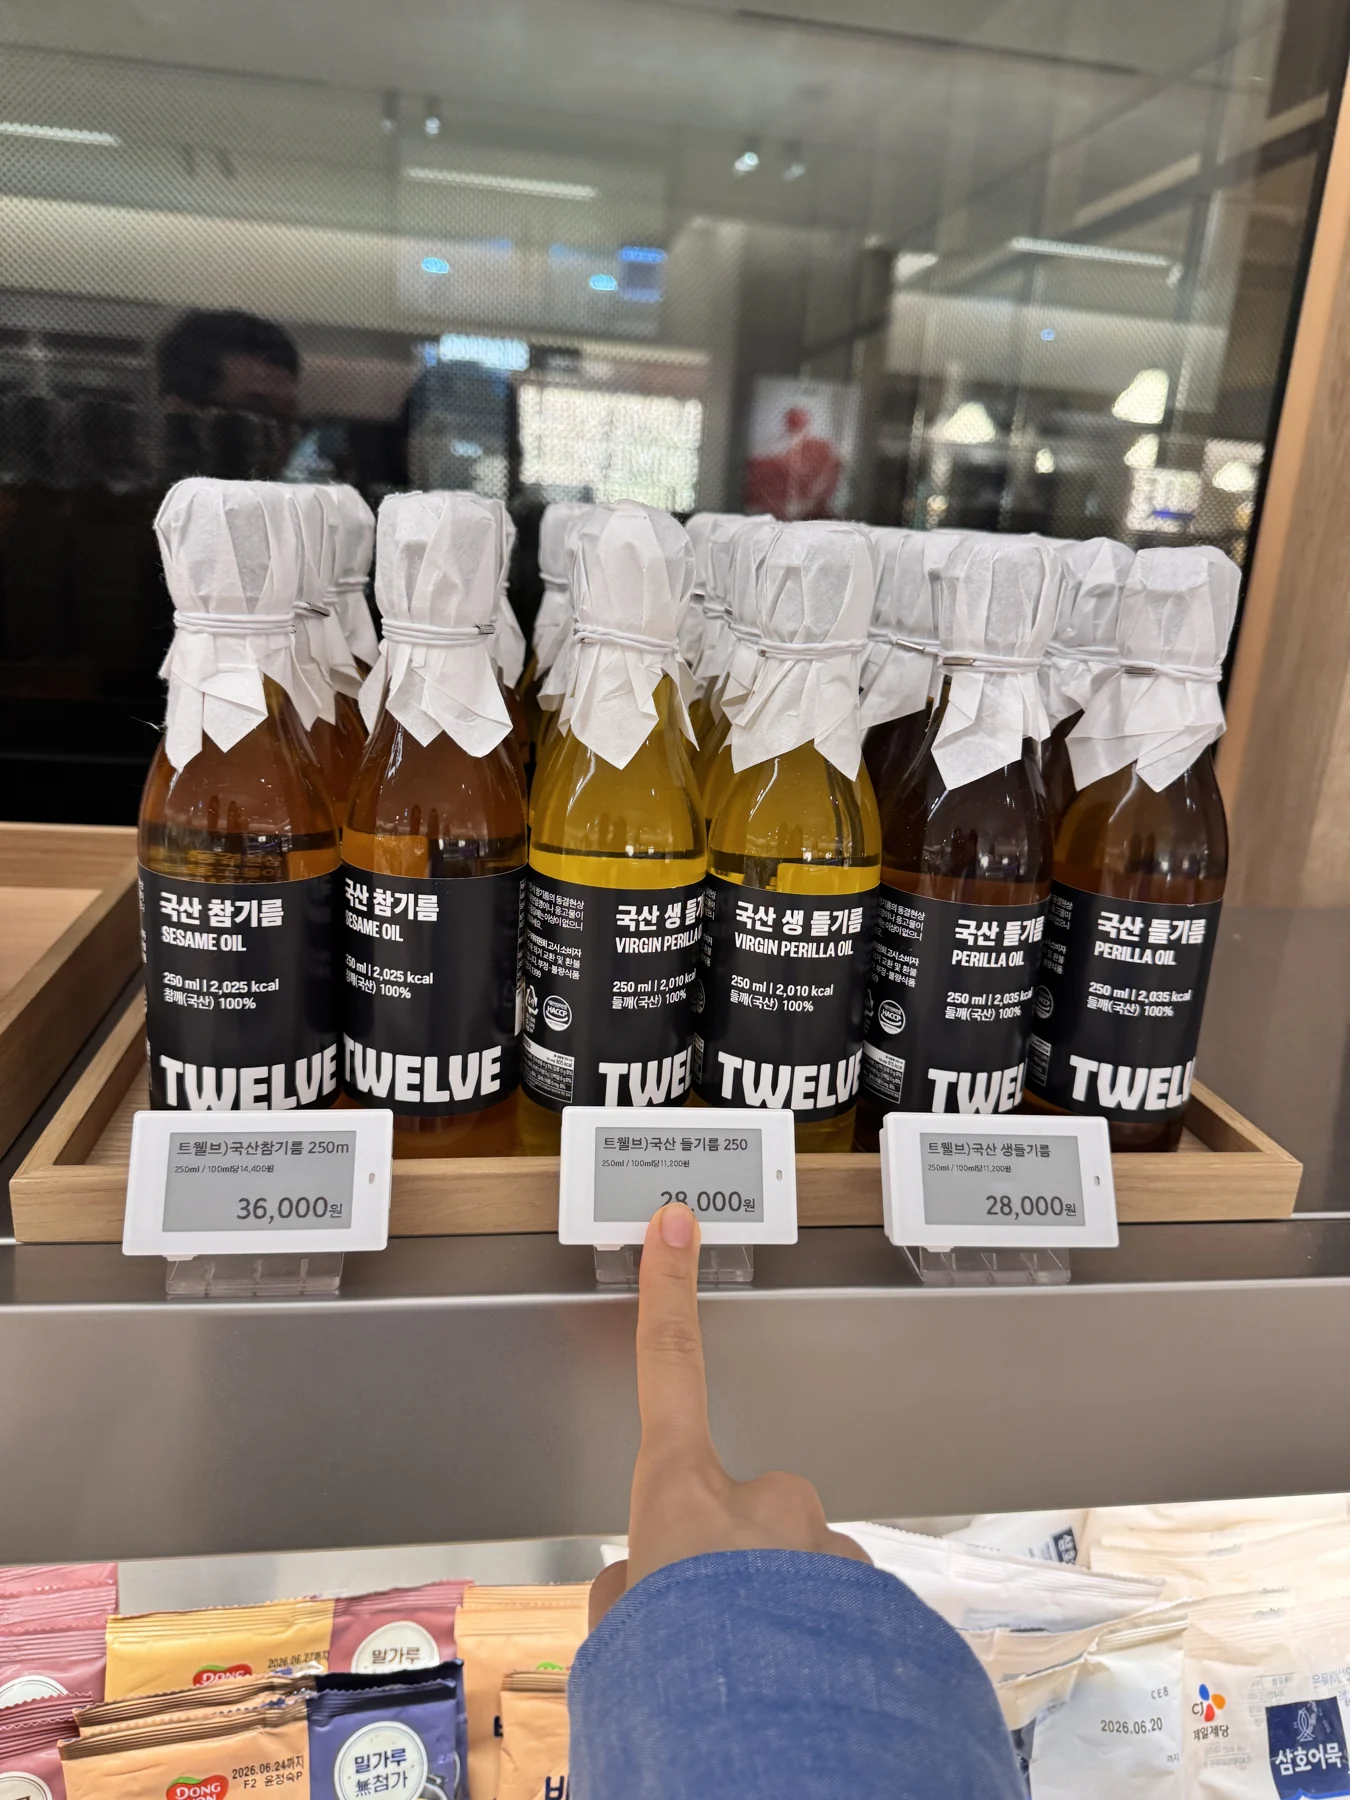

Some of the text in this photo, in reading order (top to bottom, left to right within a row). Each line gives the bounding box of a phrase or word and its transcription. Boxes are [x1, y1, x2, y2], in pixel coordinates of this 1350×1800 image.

[159, 891, 284, 928] 국산 참기름
[344, 877, 440, 922] 국산 참기름
[344, 909, 404, 942] SESAME OIL
[616, 905, 660, 931] 국산
[664, 902, 682, 929] 생
[735, 901, 776, 932] 국산
[782, 909, 804, 936] 생
[810, 907, 863, 937] 들기름
[1097, 911, 1145, 942] 국산
[1148, 918, 1206, 945] 들기름
[161, 926, 247, 951] SESAME OIL
[615, 937, 662, 953] VIRGIN
[663, 926, 698, 951] PERILLA
[955, 919, 1000, 946] 국산
[1003, 915, 1045, 947] 들기름
[560, 946, 582, 958] 소비자
[734, 932, 778, 957] VIRGIN
[781, 939, 836, 958] PERILLA
[837, 940, 854, 957] OIL
[1094, 941, 1177, 966] PERILLA OIL
[898, 954, 919, 966] 소비자
[951, 949, 1025, 967] PERILLA OIL
[162, 971, 183, 988] 250
[184, 978, 200, 991] ml
[210, 981, 249, 995] 2,025
[251, 978, 279, 993] kcal
[356, 961, 367, 975] ml
[373, 966, 405, 983] 2,025
[407, 971, 434, 985] kcal
[613, 981, 635, 993] 250
[637, 980, 651, 992] ml
[660, 975, 684, 991] 2,010
[685, 968, 697, 984] kcal
[380, 983, 412, 999] 100%
[731, 974, 750, 989] 250
[752, 981, 767, 993] ml
[776, 983, 809, 997] 2,010
[811, 984, 834, 996] kcal
[946, 992, 969, 1005] 250
[971, 993, 986, 1005] ml
[994, 992, 1020, 1006] 2,035
[1020, 986, 1034, 1001] kcal
[1088, 981, 1112, 996] 250
[1113, 988, 1129, 999] ml
[1138, 990, 1171, 1004] 2,035
[1171, 989, 1192, 1002] kcal
[163, 987, 256, 1010] 참깨(국산) 100%
[612, 989, 687, 1010] 들깨(국산) 100%
[730, 988, 814, 1012] 들깨(국산) 100%
[1087, 995, 1174, 1017] 들깨(국산) 100%
[547, 1005, 567, 1017] HACCP
[882, 1009, 902, 1021] HACCP
[945, 1006, 1021, 1021] 들깨(국산) 100%
[160, 1042, 337, 1111] TWELVE
[343, 1032, 501, 1102] TWELVE
[718, 1047, 862, 1111] TWELVE
[176, 1141, 350, 1157] 트웰브)국산참기름 250m
[603, 1137, 748, 1152] 트웰브)국산 들기름 250
[928, 1142, 1051, 1158] 트웰브)국산 생들기름
[174, 1165, 200, 1174] 250ml
[602, 1159, 625, 1168] 250ml
[928, 1164, 950, 1172] 250ml
[236, 1196, 343, 1225] 36,000원
[986, 1195, 1077, 1220] 28,000원
[372, 1647, 420, 1665] 밀가루
[1151, 1686, 1169, 1700] CE8
[1192, 1702, 1204, 1717] CJ
[1101, 1717, 1163, 1734] 2026.06.20
[1193, 1725, 1229, 1741] 제일제당
[232, 1755, 304, 1780] 2026.06.24까지
[354, 1748, 407, 1774] 밀가루
[1167, 1753, 1180, 1763] 까지
[1275, 1742, 1342, 1776] 삼호어묵
[175, 1782, 221, 1800] DONG
[243, 1778, 257, 1789] F2
[355, 1770, 408, 1797] 無첨가
